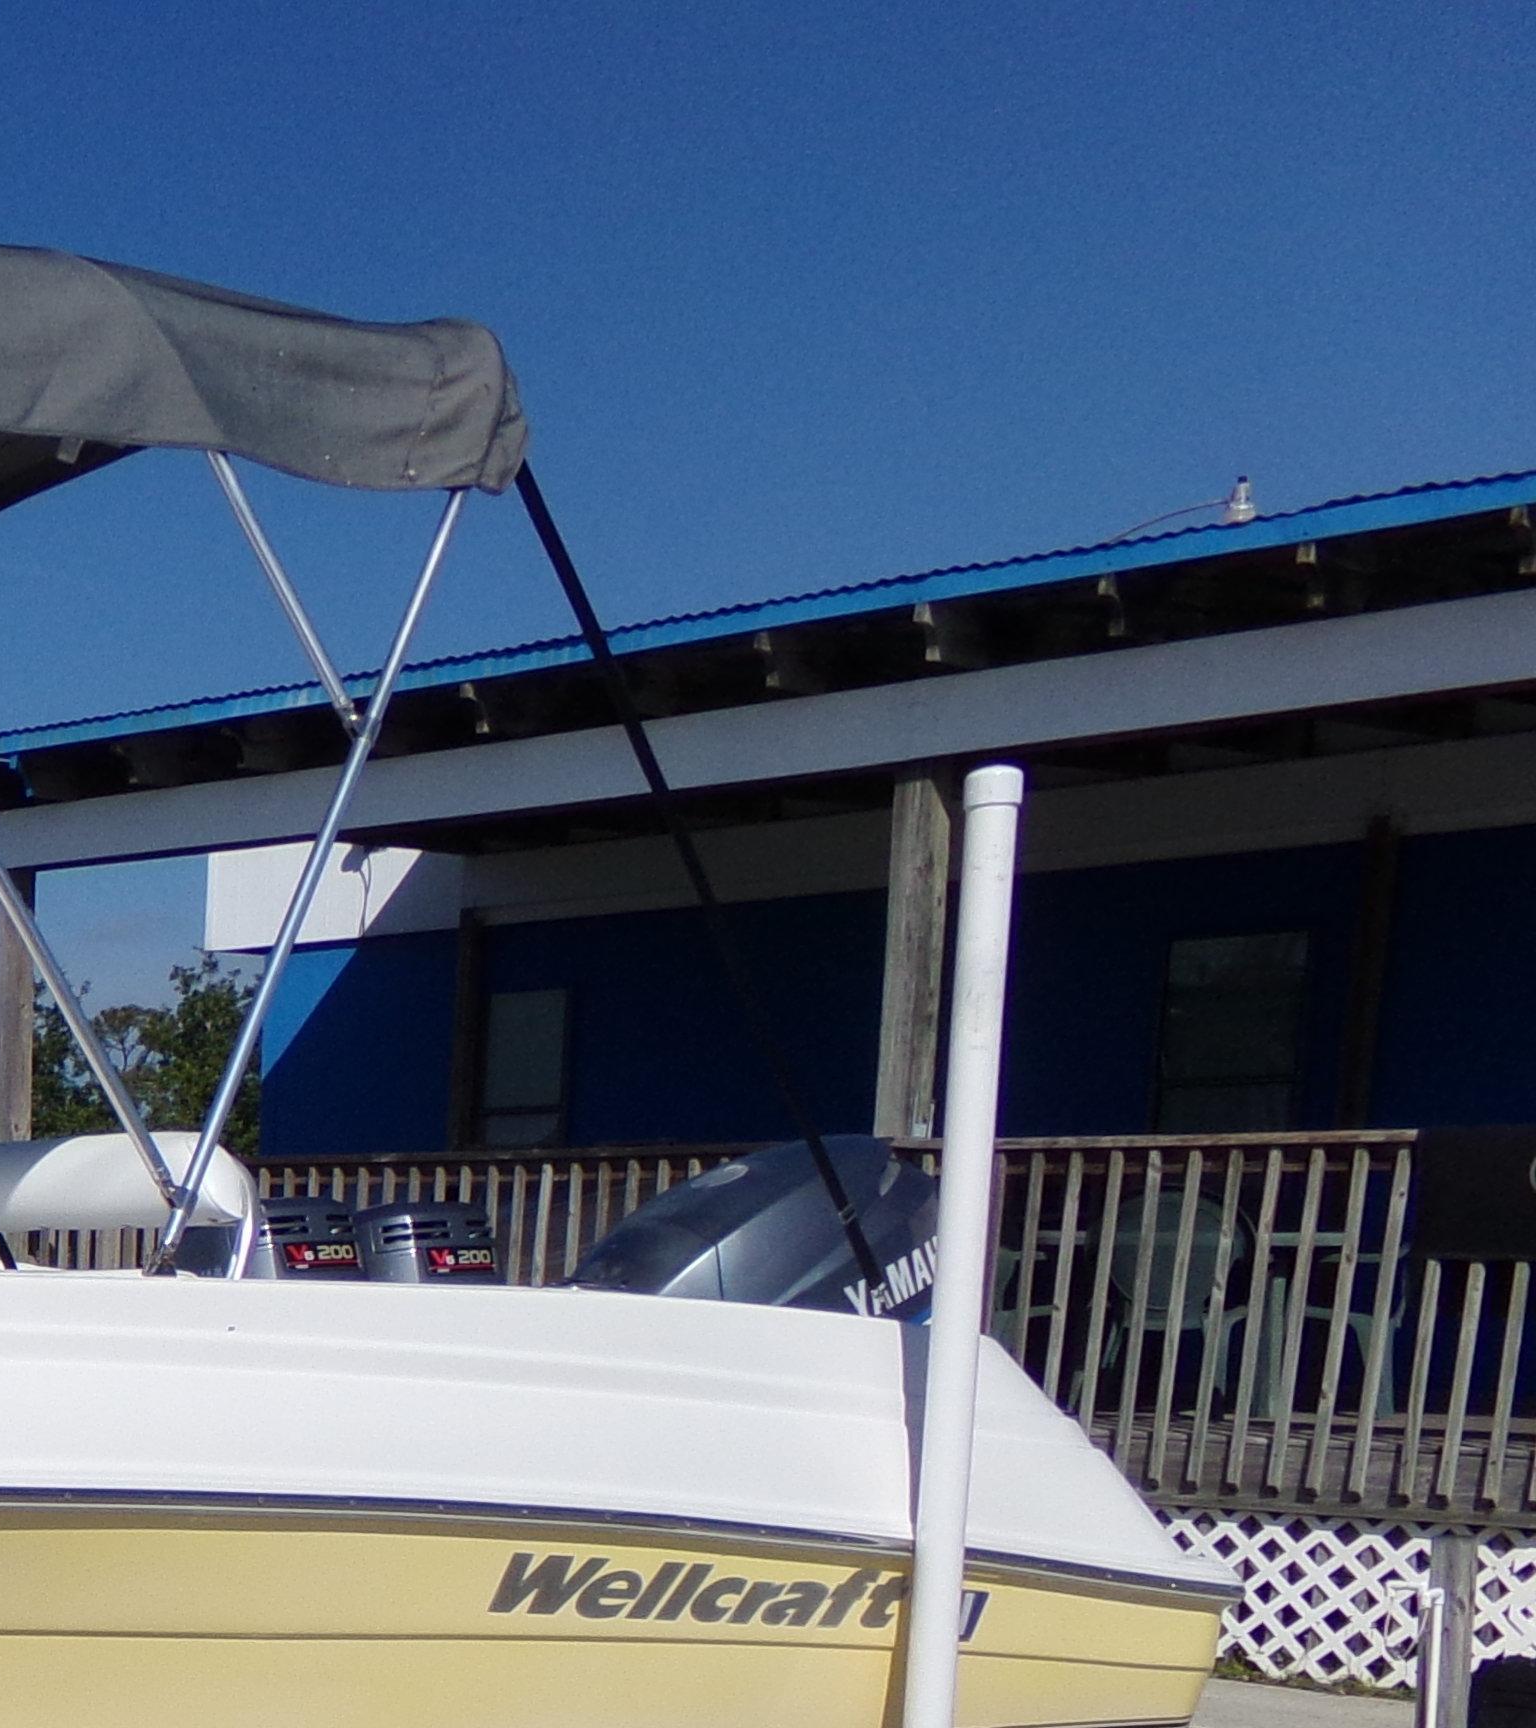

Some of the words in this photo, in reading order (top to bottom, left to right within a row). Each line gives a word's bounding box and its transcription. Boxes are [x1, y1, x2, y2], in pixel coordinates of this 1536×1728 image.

[316, 1244, 355, 1260] 200
[458, 1249, 491, 1264] 200
[486, 1552, 909, 1629] Wellcraft
